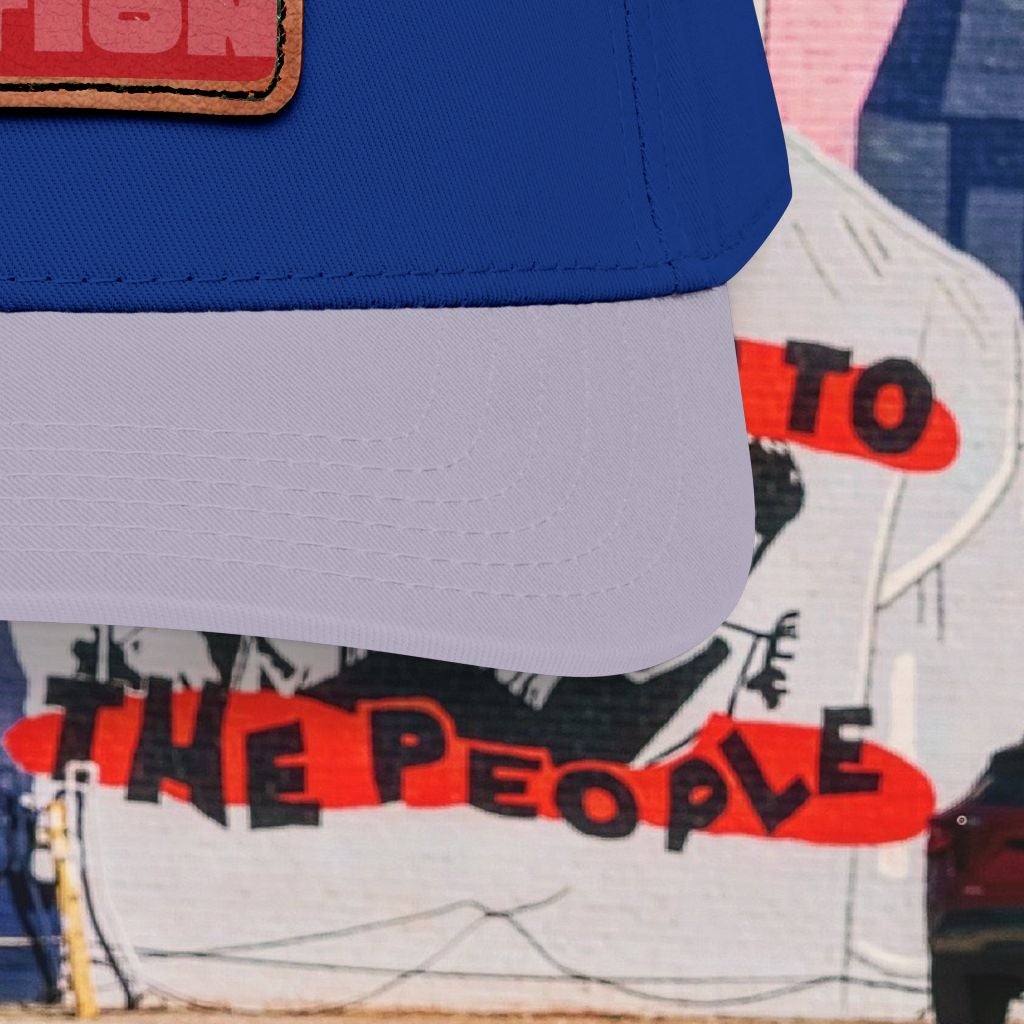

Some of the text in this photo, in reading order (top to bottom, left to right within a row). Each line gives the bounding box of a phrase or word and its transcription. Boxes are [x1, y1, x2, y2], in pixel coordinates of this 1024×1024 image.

[784, 339, 934, 454] TO
[46, 677, 881, 851] THE PEOPLE
